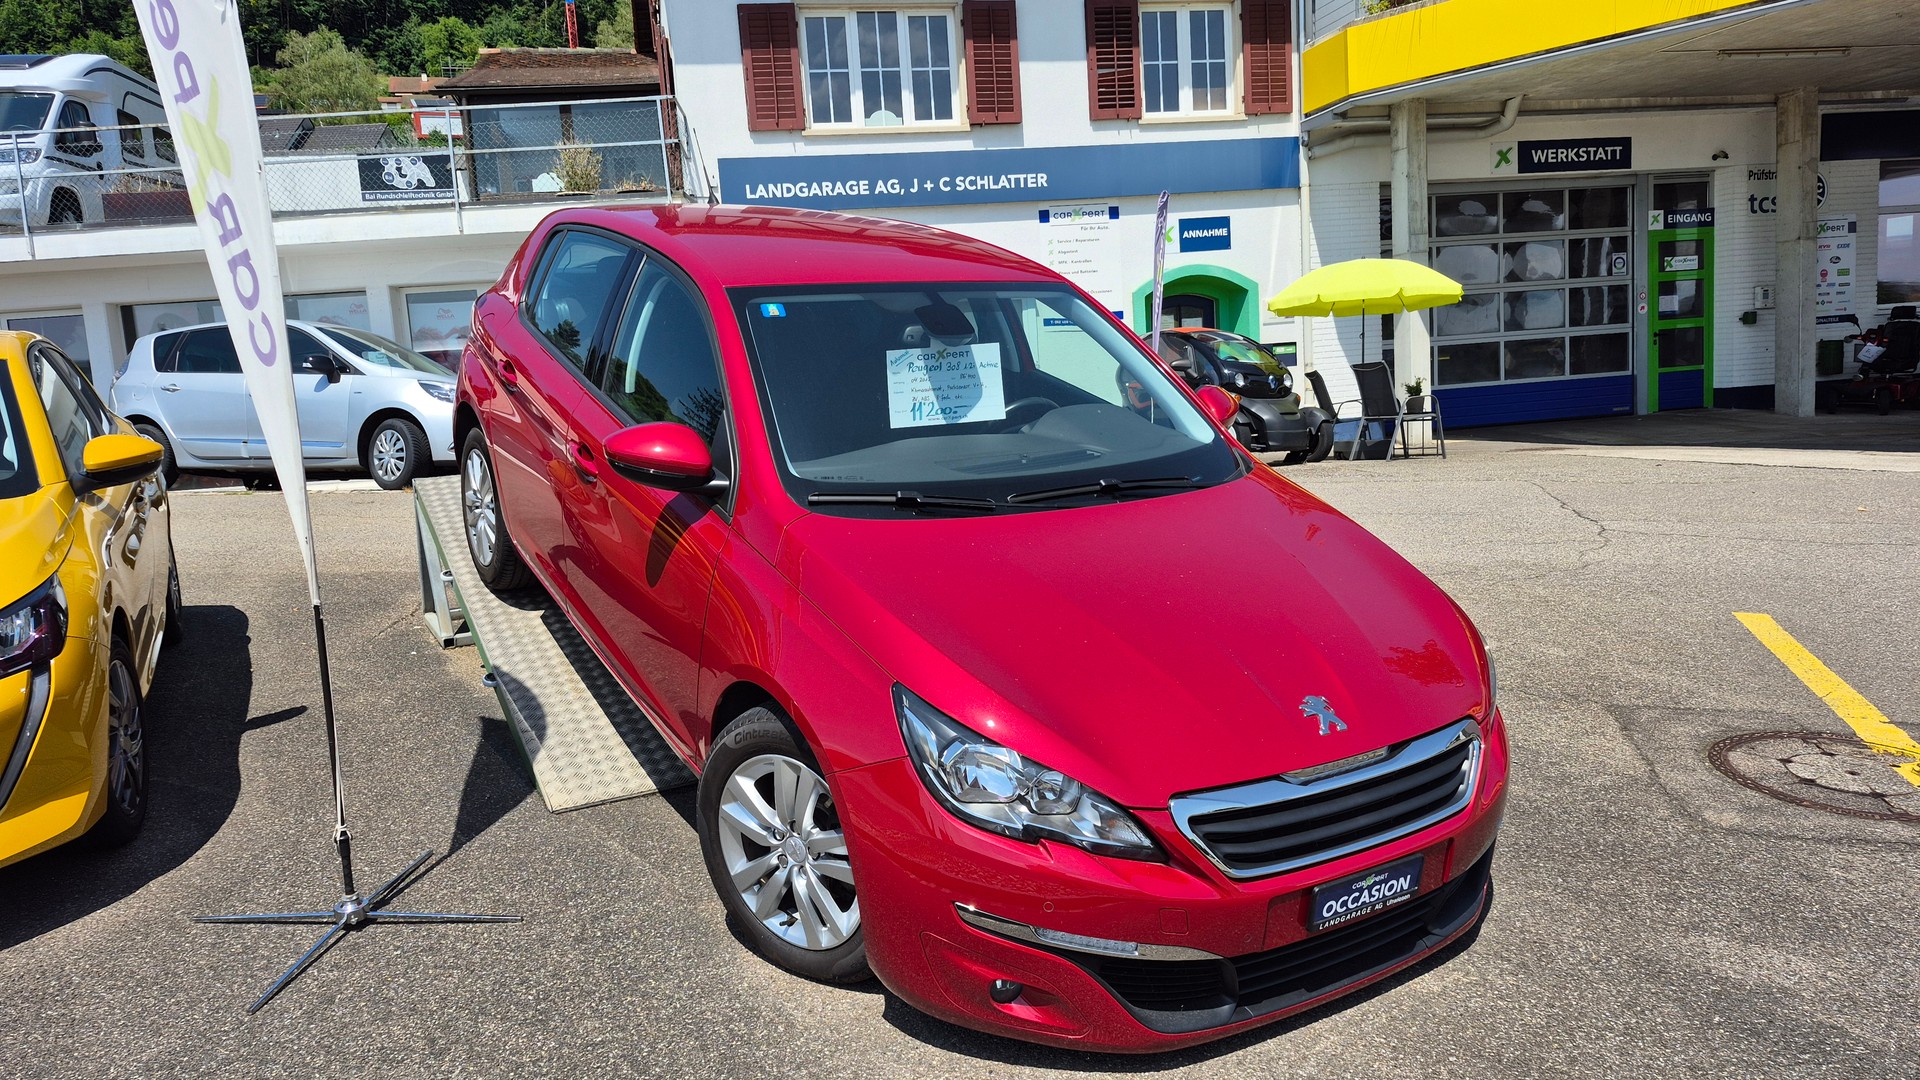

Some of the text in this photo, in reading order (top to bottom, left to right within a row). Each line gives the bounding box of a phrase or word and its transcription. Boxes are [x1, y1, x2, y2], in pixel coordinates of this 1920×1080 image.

[1531, 146, 1623, 164] WERKSTATT
[745, 173, 1048, 199] LANDGARAGE AG, J + C SCHLATTER
[1667, 212, 1712, 224] EINGANG
[1182, 228, 1228, 239] ANNAHME
[946, 362, 960, 371] 308
[979, 361, 999, 369] Active
[1322, 875, 1411, 918] OCCASION
[1319, 906, 1371, 930] LANDGARAGE
[1374, 902, 1383, 911] AG
